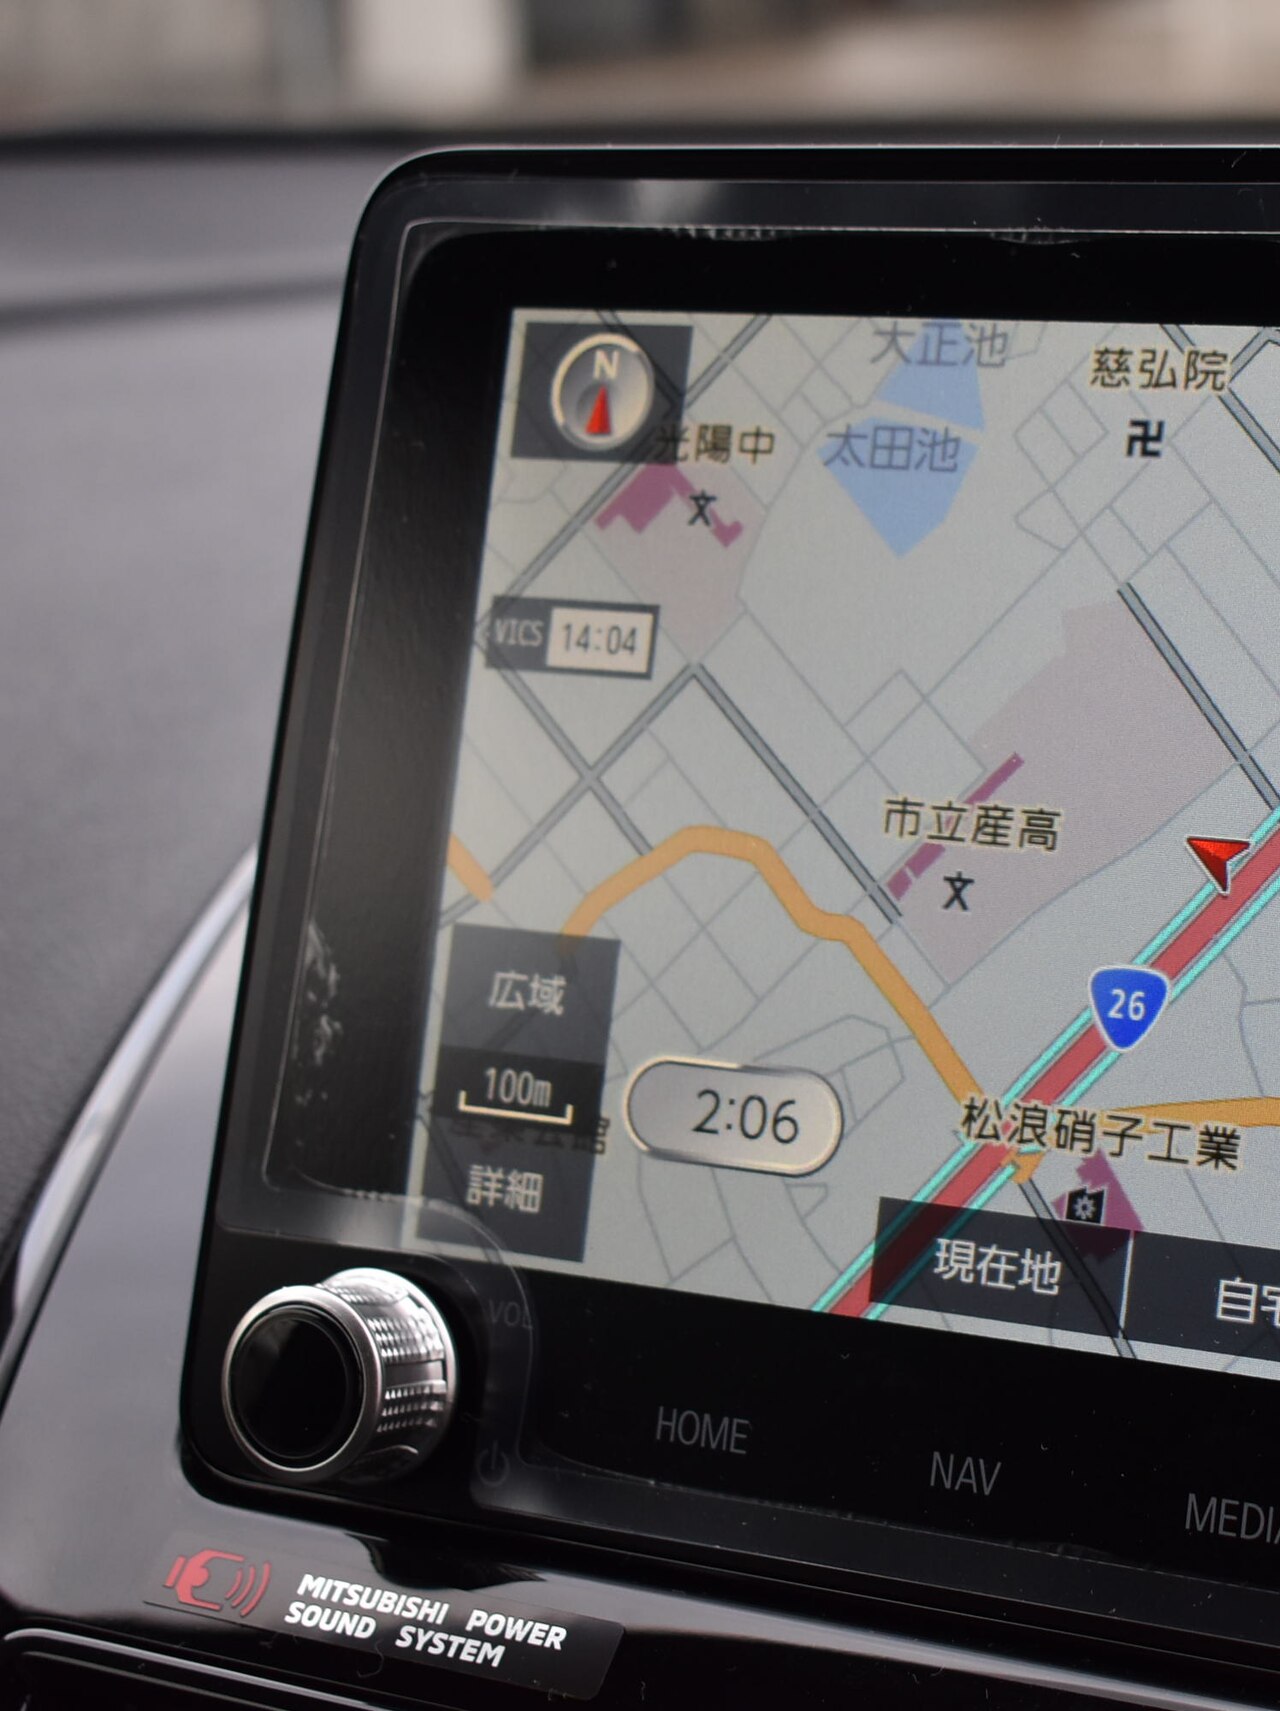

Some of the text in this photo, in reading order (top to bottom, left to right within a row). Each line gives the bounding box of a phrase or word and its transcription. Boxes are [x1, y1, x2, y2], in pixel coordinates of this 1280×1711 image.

[870, 321, 1009, 369] 大正池
[1090, 346, 1228, 392] 慈弘院
[823, 424, 962, 473] 太田池
[493, 617, 544, 647] VICS
[561, 621, 638, 656] 14:04
[883, 798, 1060, 851] 市立産高
[488, 970, 567, 1017] 広域
[1108, 988, 1146, 1022] 26
[485, 1067, 553, 1109] 100m
[693, 1089, 799, 1144] 2:06
[961, 1097, 1241, 1171] 松浪硝子工業
[466, 1164, 544, 1214] 詳細
[934, 1237, 1062, 1296] 現在地
[655, 1405, 751, 1456] HOME
[929, 1451, 1002, 1496] NAV
[284, 1601, 505, 1669] SOUND SYSTEM
[296, 1574, 567, 1652] MITSUBISHI POWER
